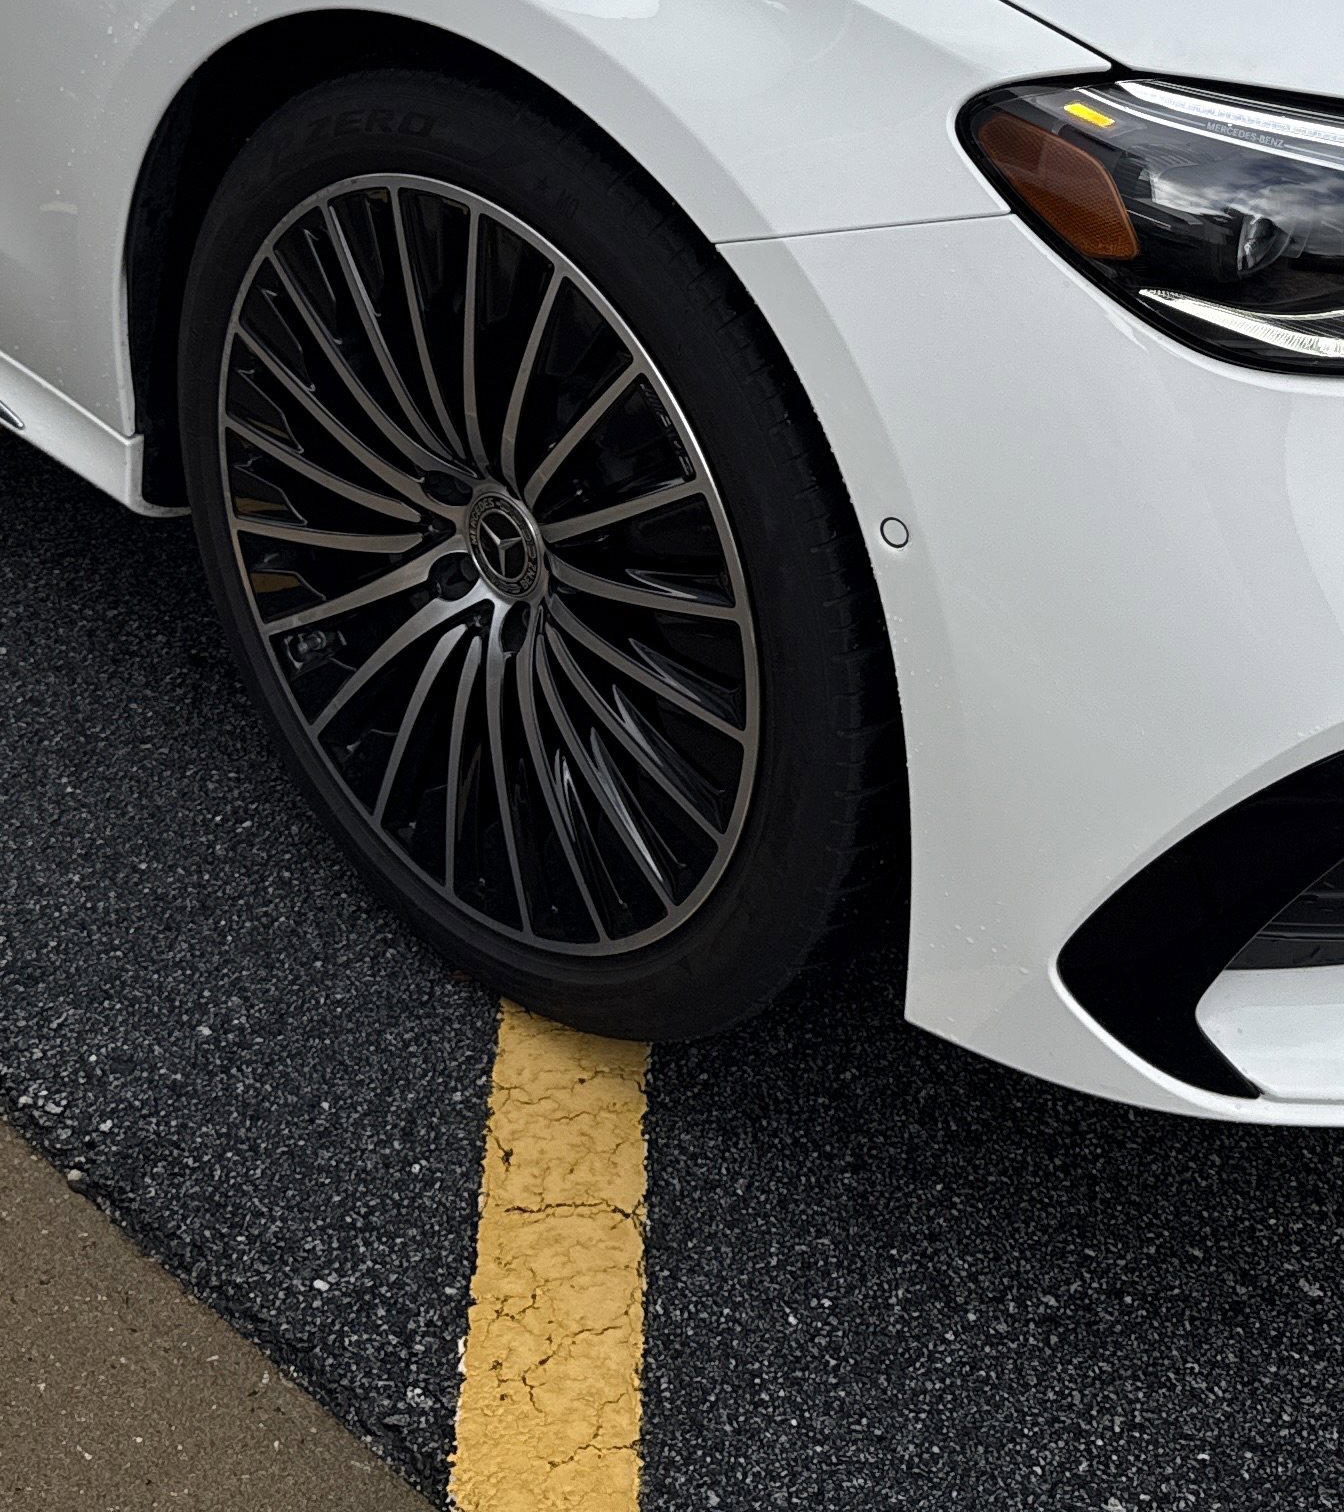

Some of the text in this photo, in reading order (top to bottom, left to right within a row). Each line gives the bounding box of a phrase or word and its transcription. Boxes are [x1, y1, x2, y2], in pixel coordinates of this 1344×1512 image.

[304, 108, 434, 146] ZERO
[1206, 121, 1285, 148] MERCEDES-BENZ
[469, 496, 496, 546] MERCEDES
[519, 561, 538, 590] BENZ
